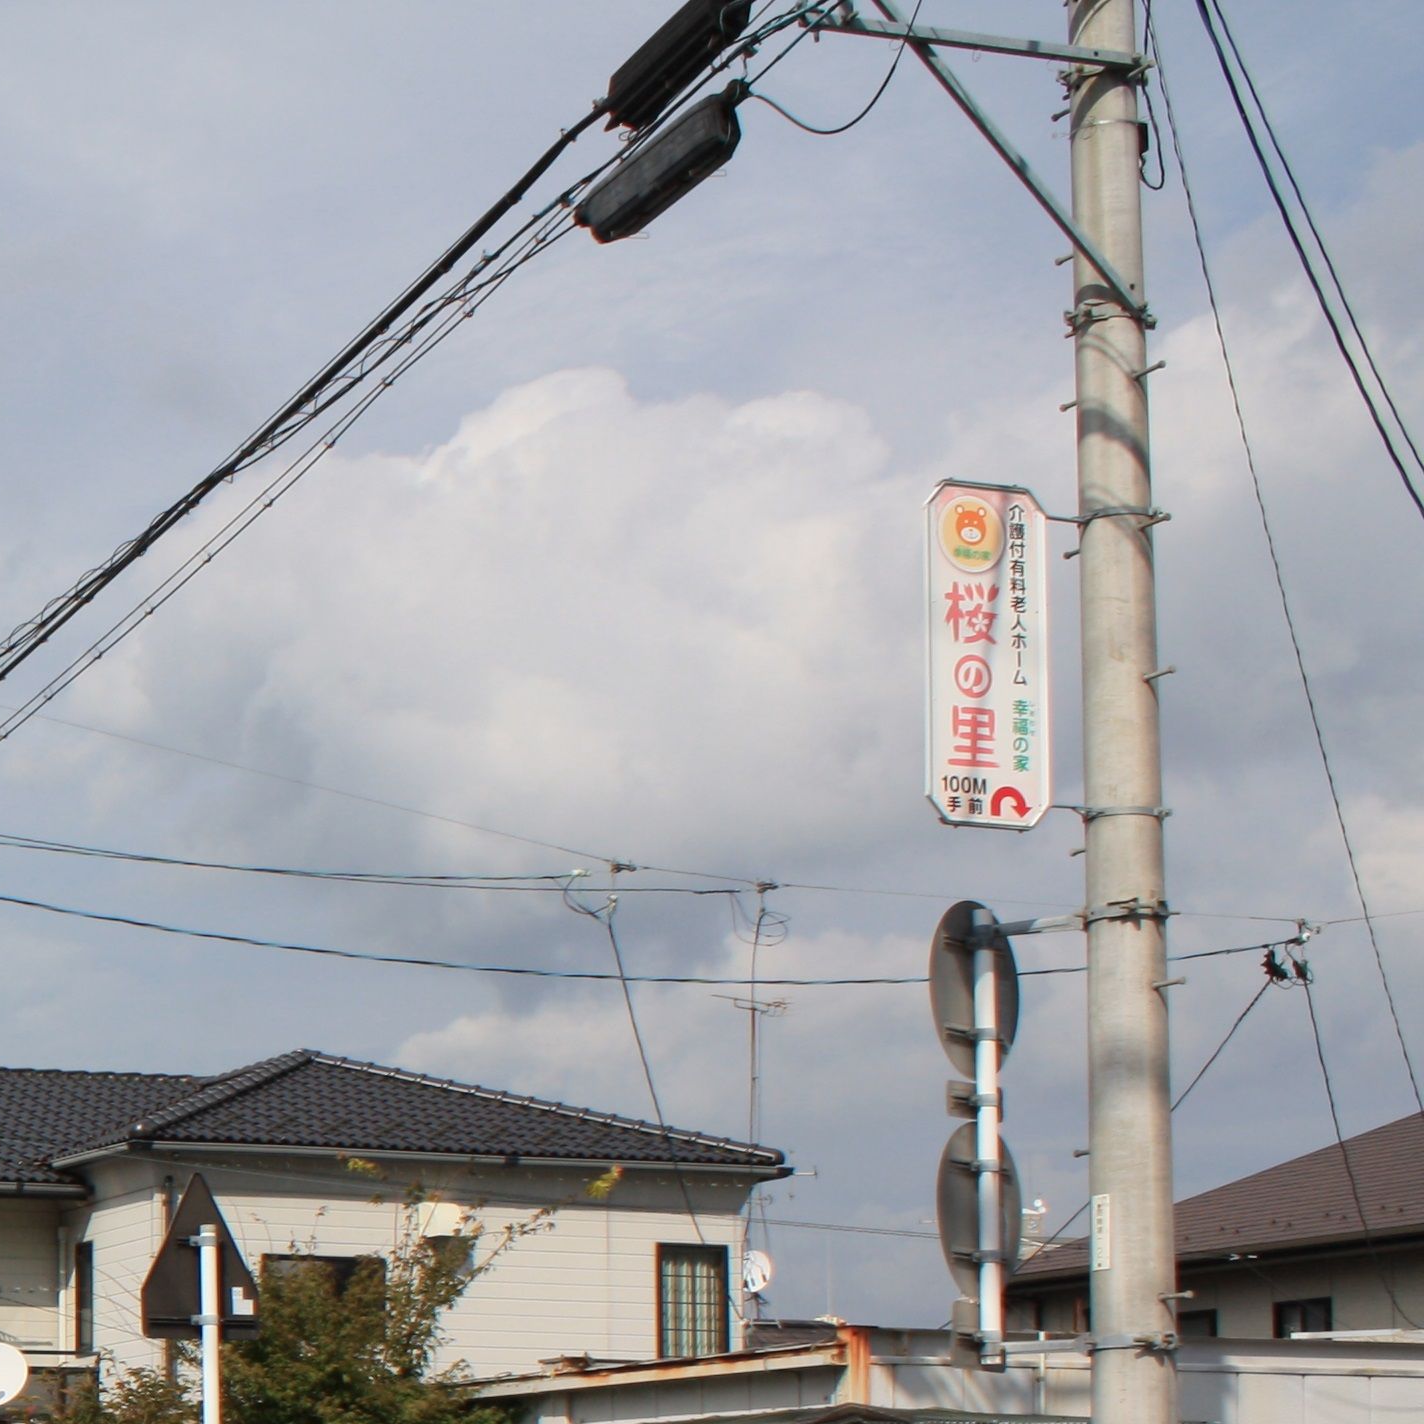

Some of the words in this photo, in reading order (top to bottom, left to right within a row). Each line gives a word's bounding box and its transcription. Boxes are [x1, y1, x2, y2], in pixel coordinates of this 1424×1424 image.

[1008, 504, 1027, 686] 介護付有料老人ホーム
[943, 580, 1000, 769] 桜の里
[1012, 699, 1030, 773] 幸福の家
[941, 775, 987, 795] 100M
[947, 796, 983, 815] 手前
